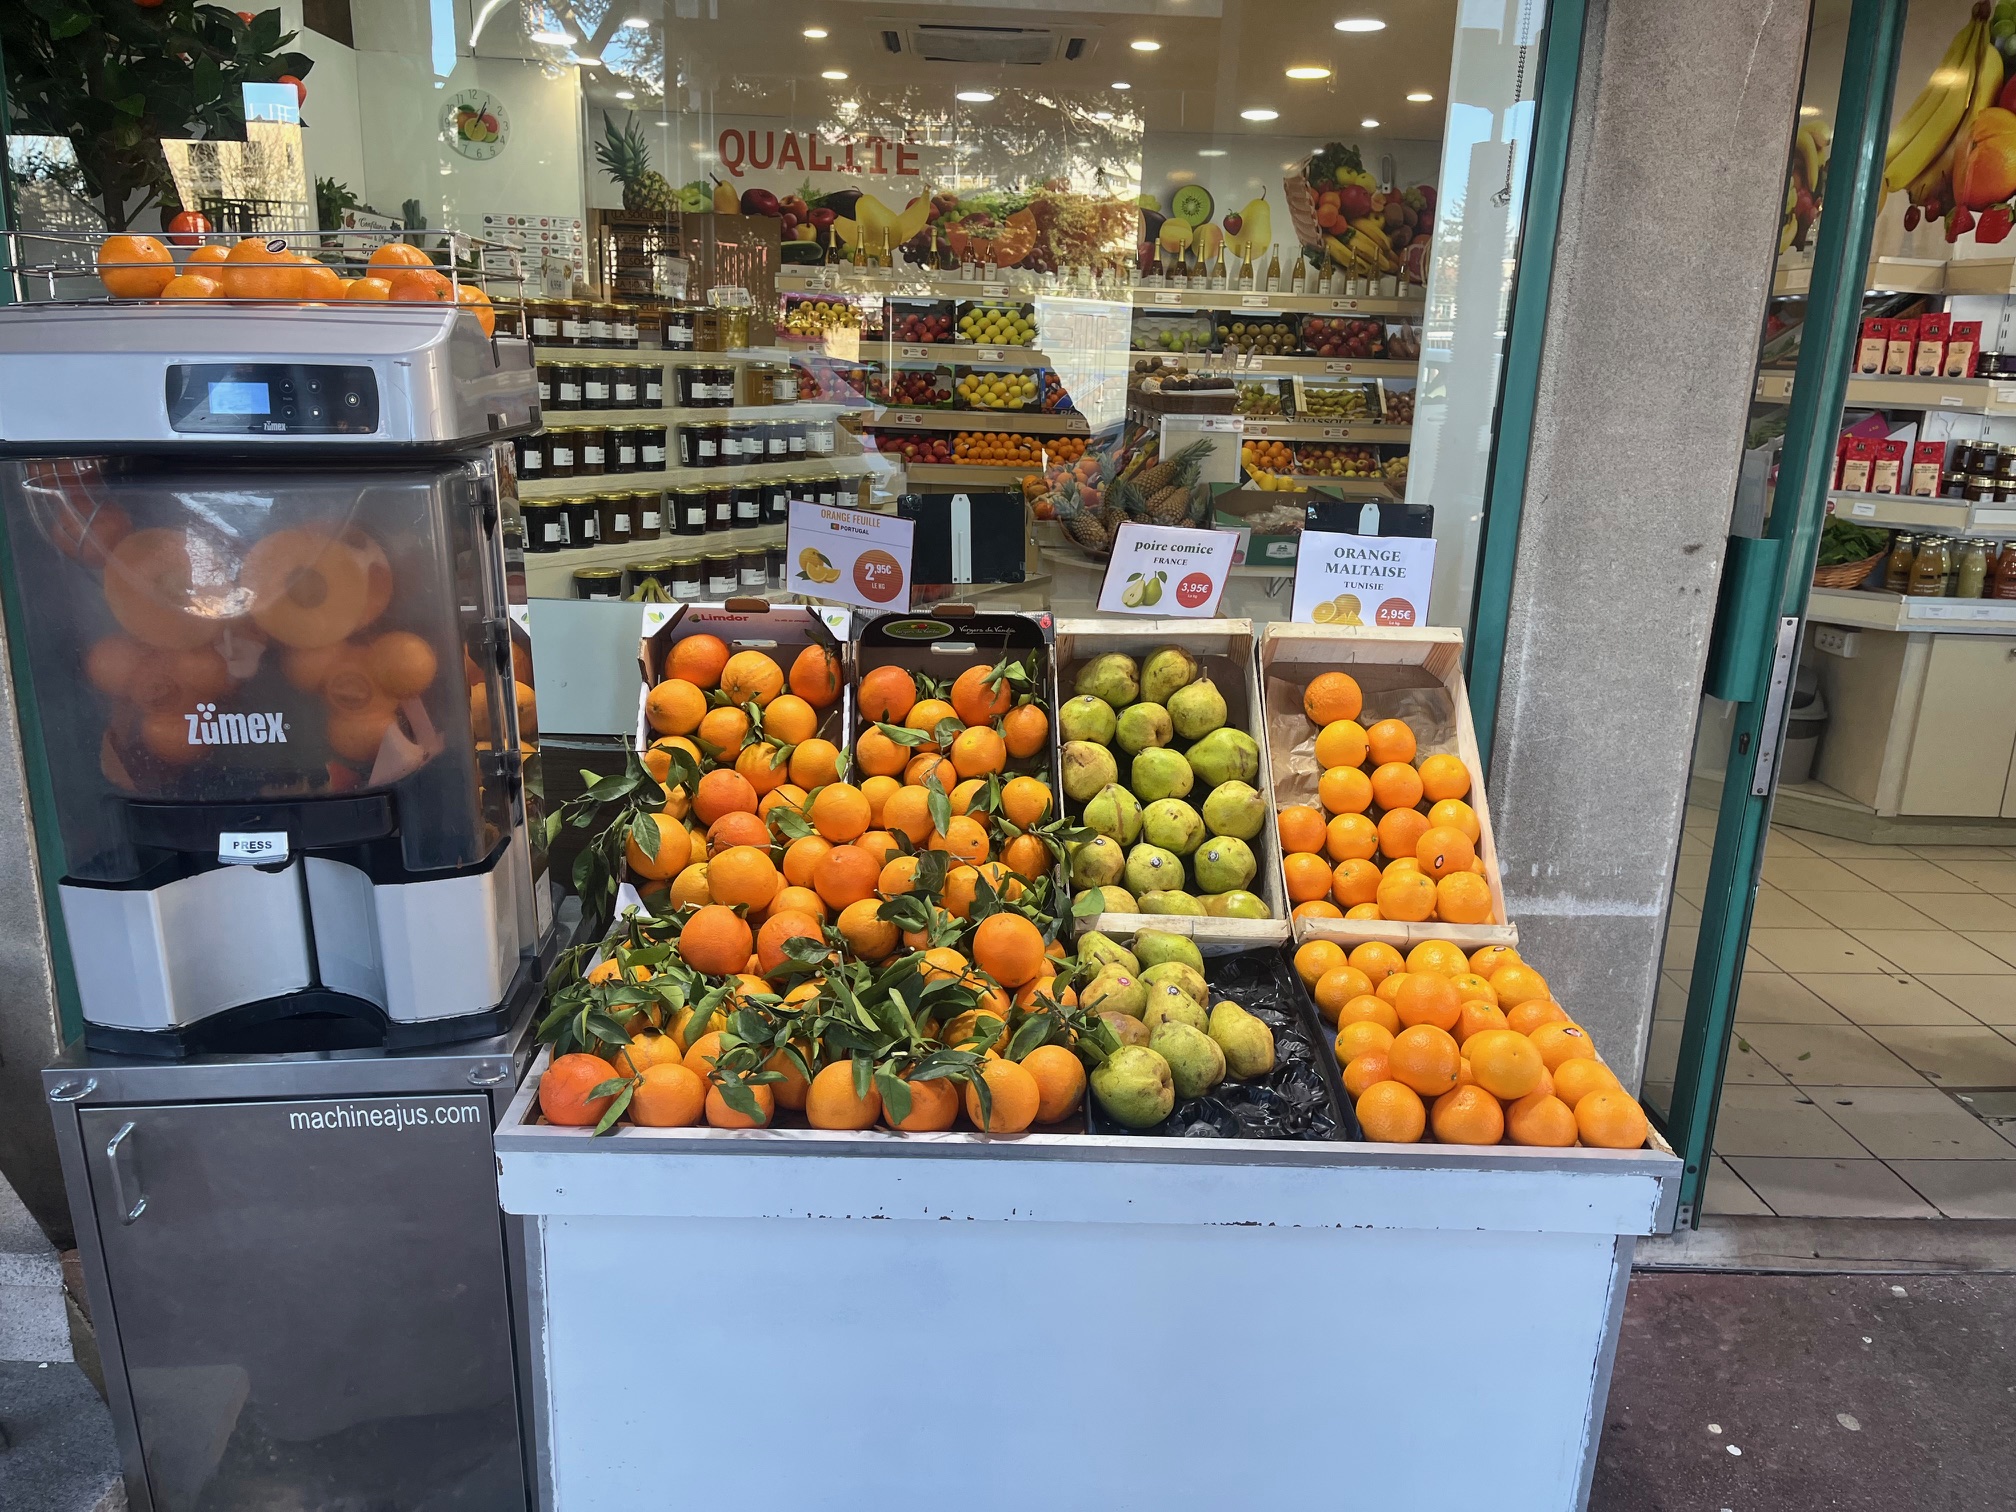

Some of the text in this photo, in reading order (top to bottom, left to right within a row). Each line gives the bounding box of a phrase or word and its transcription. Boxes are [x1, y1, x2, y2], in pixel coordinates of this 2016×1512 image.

[456, 94, 463, 104] 11
[468, 89, 477, 99] 12
[497, 106, 502, 116] 2
[503, 121, 508, 131] 3
[463, 144, 468, 154] 7
[476, 148, 482, 158] 6
[490, 146, 496, 156] 5
[820, 509, 880, 528] ORANGE FEUILLE
[840, 526, 870, 535] PORTUGAL
[1134, 540, 1214, 554] poire comice
[1334, 547, 1401, 562] ORANGE
[1153, 557, 1188, 566] FRANCE
[1325, 562, 1406, 578] MALTAISE
[1181, 582, 1209, 594] 3,95€
[1344, 582, 1384, 590] TUNISIE
[700, 614, 750, 622] Limdor
[1381, 609, 1412, 620] 2,95€
[959, 625, 984, 635] Vergers
[233, 841, 272, 850] PRESS
[289, 1104, 481, 1132] machineajus.com
